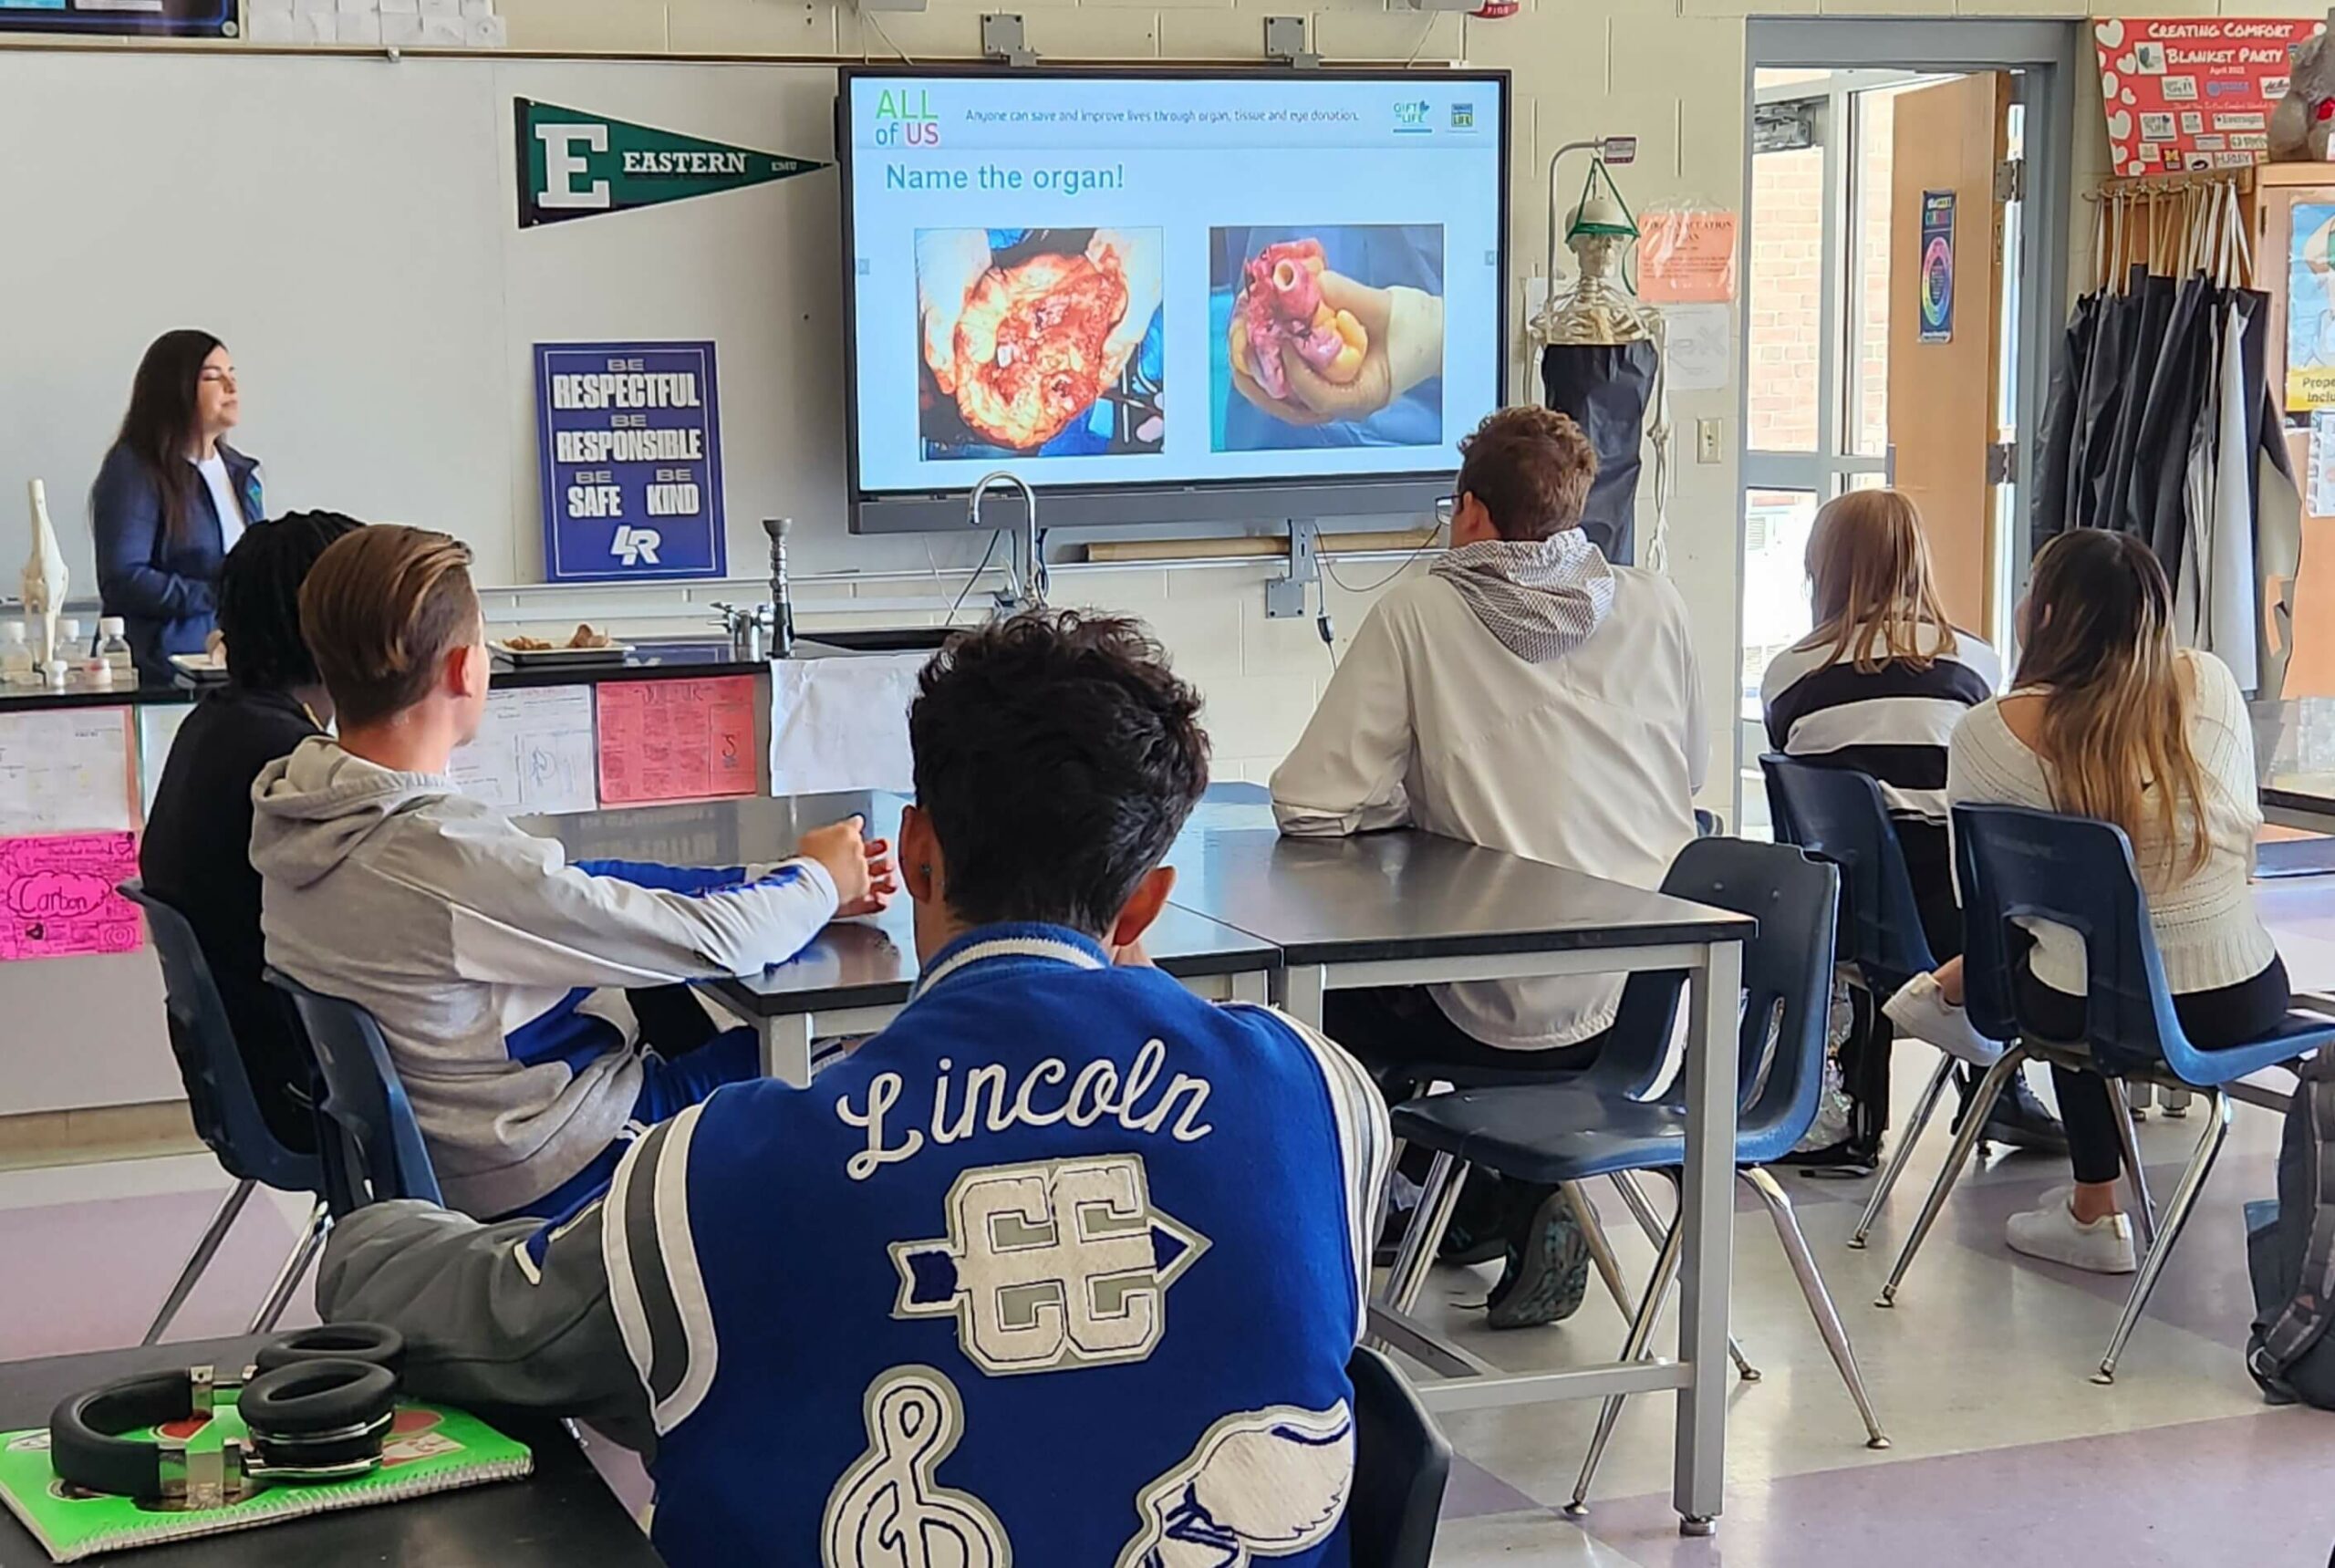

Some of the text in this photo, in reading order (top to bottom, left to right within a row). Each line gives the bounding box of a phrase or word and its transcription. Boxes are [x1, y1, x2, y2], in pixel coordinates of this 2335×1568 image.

[2147, 22, 2293, 37] CREATING COMFORT
[2166, 47, 2236, 64] BLANKET
[2239, 47, 2283, 63] PARTY
[876, 89, 939, 119] ALL
[966, 109, 1007, 122] Anyone
[1010, 111, 1028, 121] can
[1031, 111, 1056, 121] save
[1059, 109, 1078, 121] and
[1081, 109, 1125, 122] improve
[1127, 109, 1150, 121] lives
[1154, 109, 1196, 123] through
[1235, 109, 1265, 120] tissue
[1268, 109, 1287, 120] and
[1290, 111, 1309, 122] eye
[876, 122, 939, 145] of US
[534, 123, 610, 208] E
[623, 151, 746, 174] EASTERN
[886, 163, 1124, 195] Name the organ!
[607, 359, 644, 371] BE
[553, 373, 700, 409] RESPECTFUL
[610, 414, 647, 427] BE
[556, 429, 702, 462] RESPONSIBLE
[576, 471, 612, 483] BE
[656, 469, 691, 482] BE
[567, 485, 623, 517] SAFE
[646, 483, 700, 515] KIND
[19, 878, 88, 913] Carbon
[835, 1038, 1213, 1180] Lincoln
